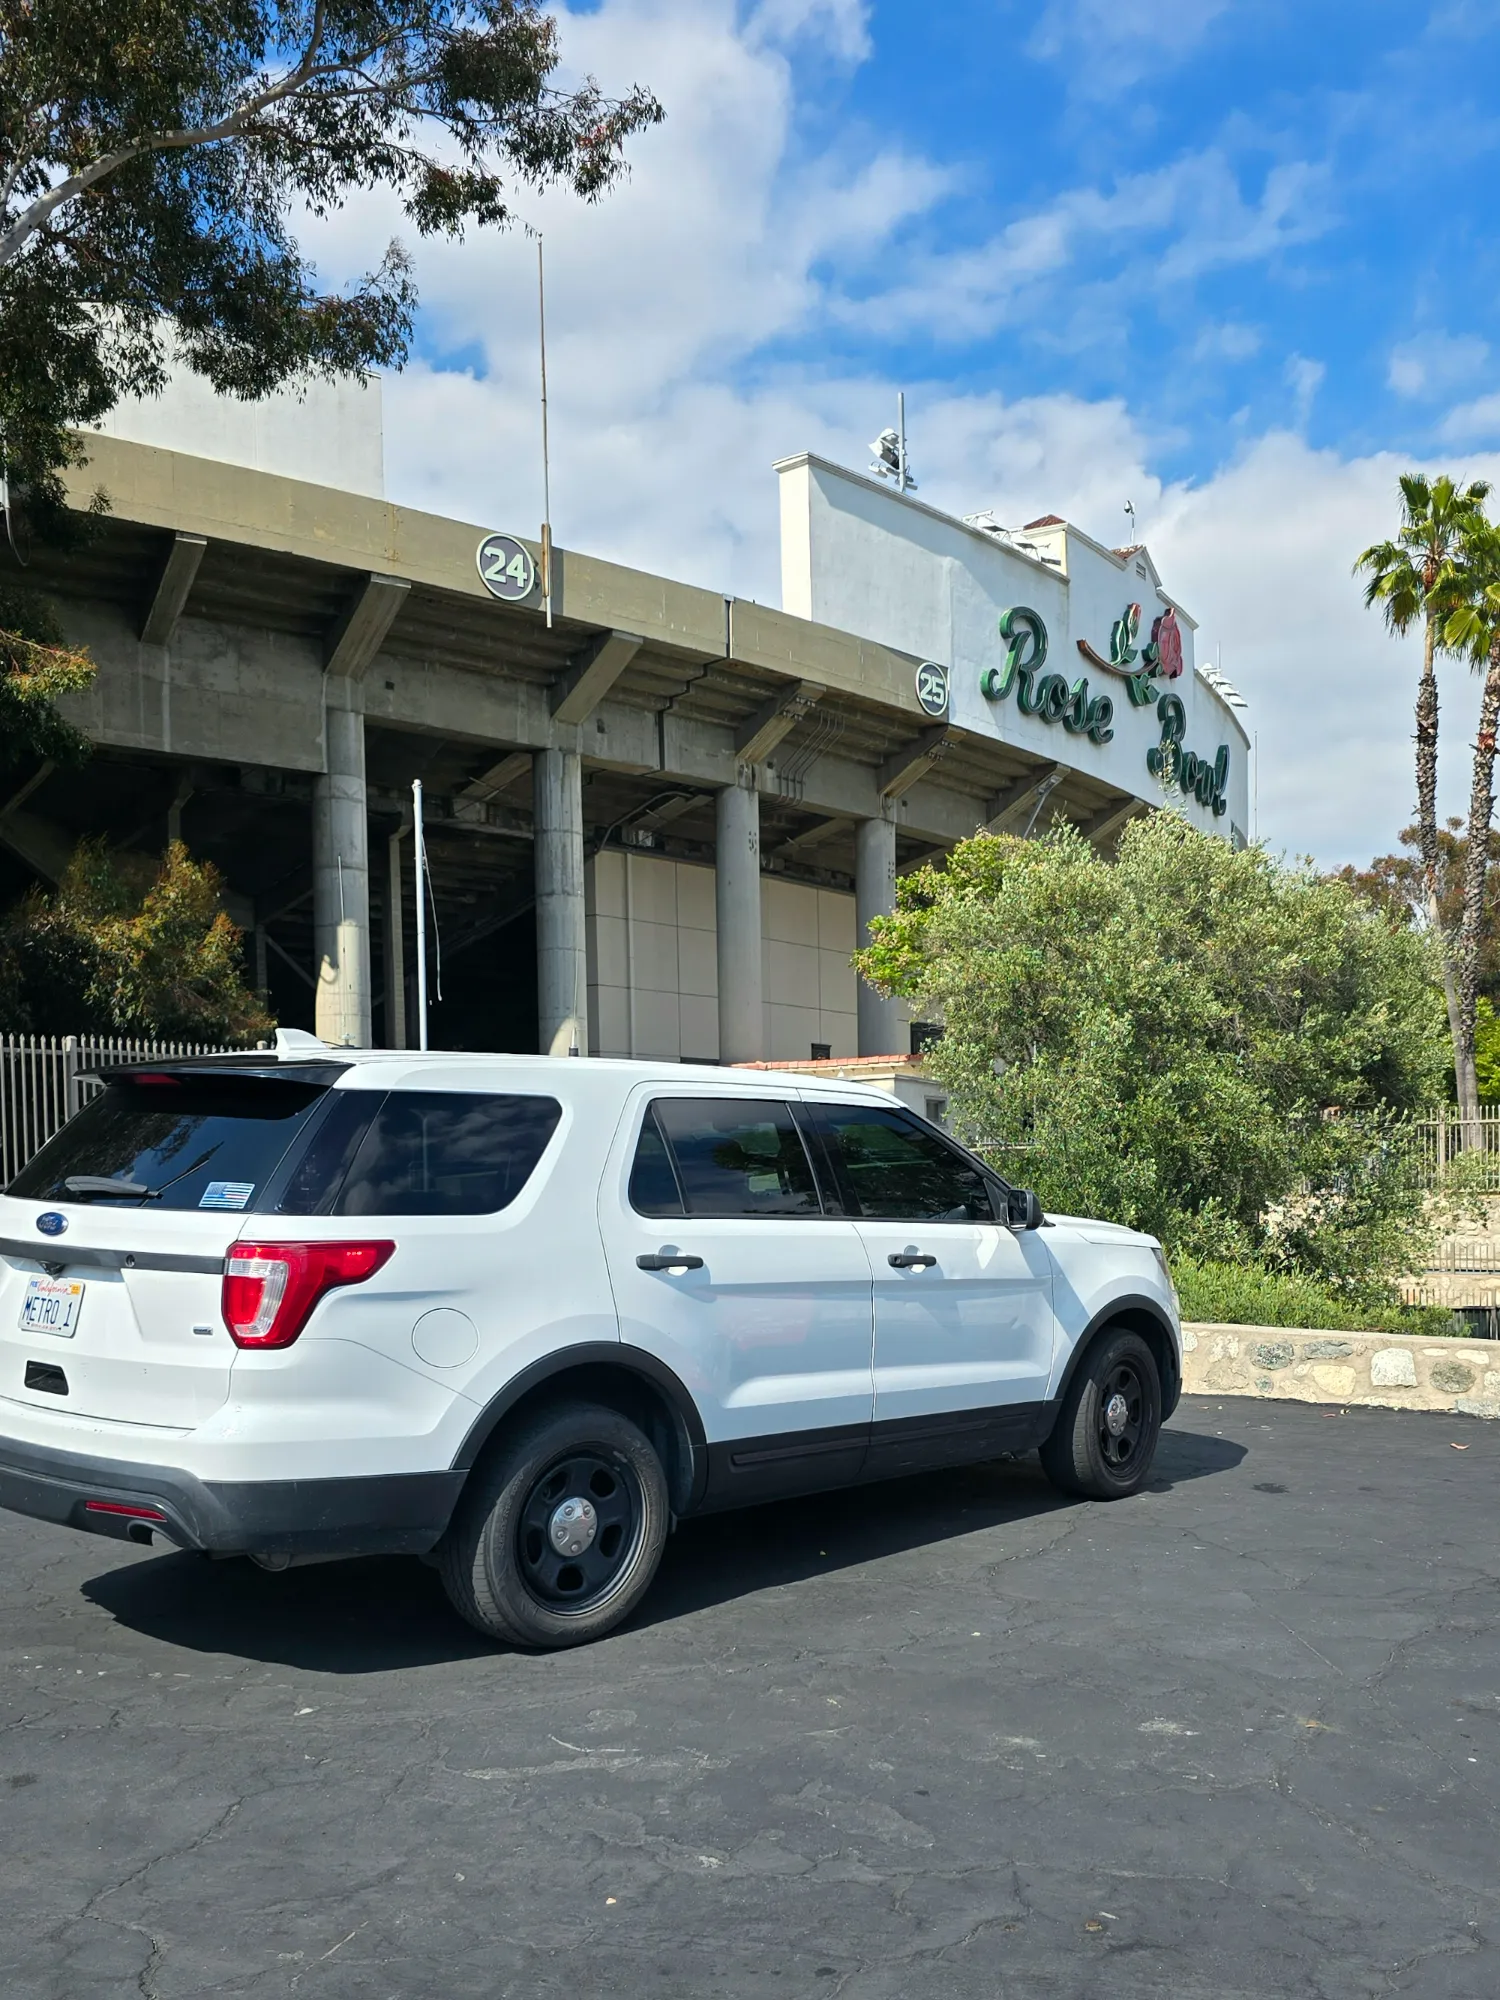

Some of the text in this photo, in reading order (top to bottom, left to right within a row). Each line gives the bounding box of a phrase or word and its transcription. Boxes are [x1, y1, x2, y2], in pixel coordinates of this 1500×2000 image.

[483, 546, 528, 588] 24
[920, 672, 945, 705] 25
[980, 606, 1230, 816] Rose Bowl
[21, 1295, 73, 1327] METRO 1
